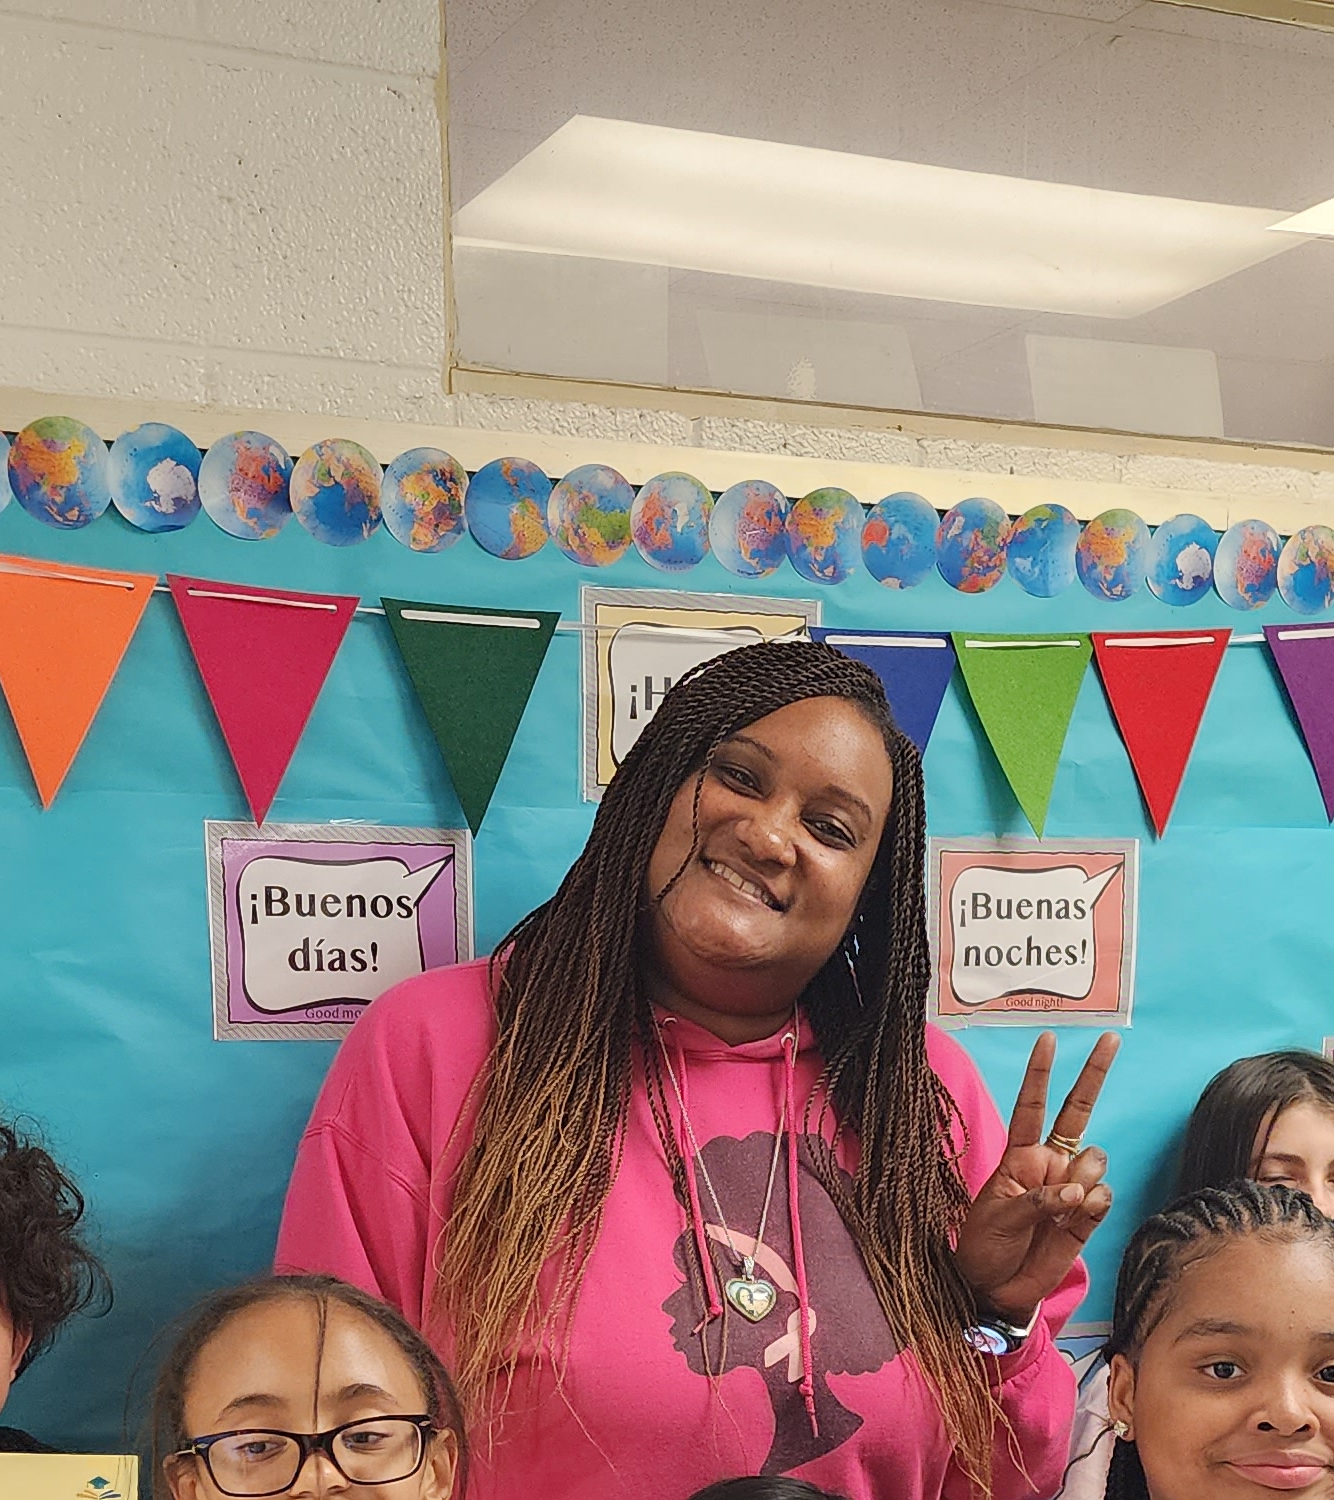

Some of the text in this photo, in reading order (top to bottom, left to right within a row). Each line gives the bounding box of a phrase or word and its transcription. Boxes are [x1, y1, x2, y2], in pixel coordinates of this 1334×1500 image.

[250, 885, 413, 924] ¡Buenos
[960, 892, 1087, 927] ¡Buenas
[288, 937, 379, 972] días!
[963, 935, 1087, 966] noches!
[305, 1007, 338, 1019] Good
[1006, 998, 1063, 1009] Good night!
